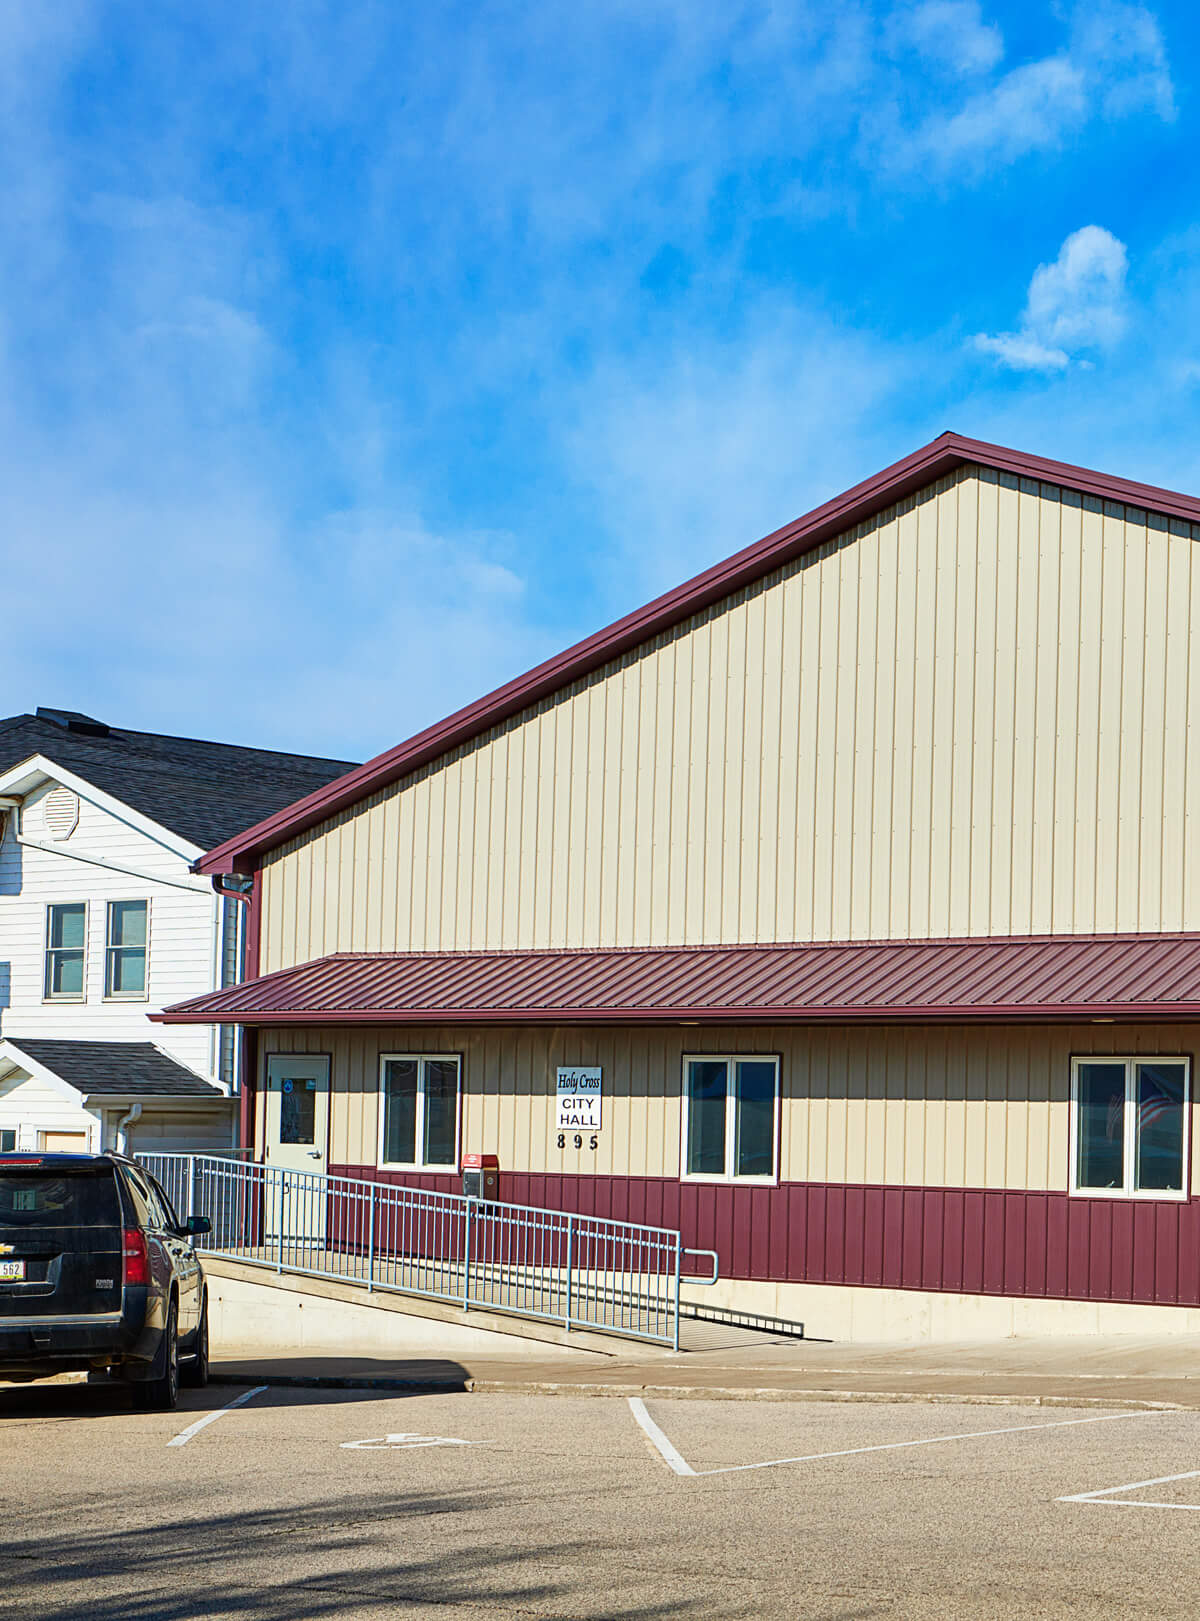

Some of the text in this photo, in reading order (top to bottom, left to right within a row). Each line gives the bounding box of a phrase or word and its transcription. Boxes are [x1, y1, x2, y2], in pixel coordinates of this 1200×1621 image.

[558, 1072, 600, 1094] Holy Cross
[562, 1099, 594, 1109] CITY
[560, 1114, 598, 1125] HALL
